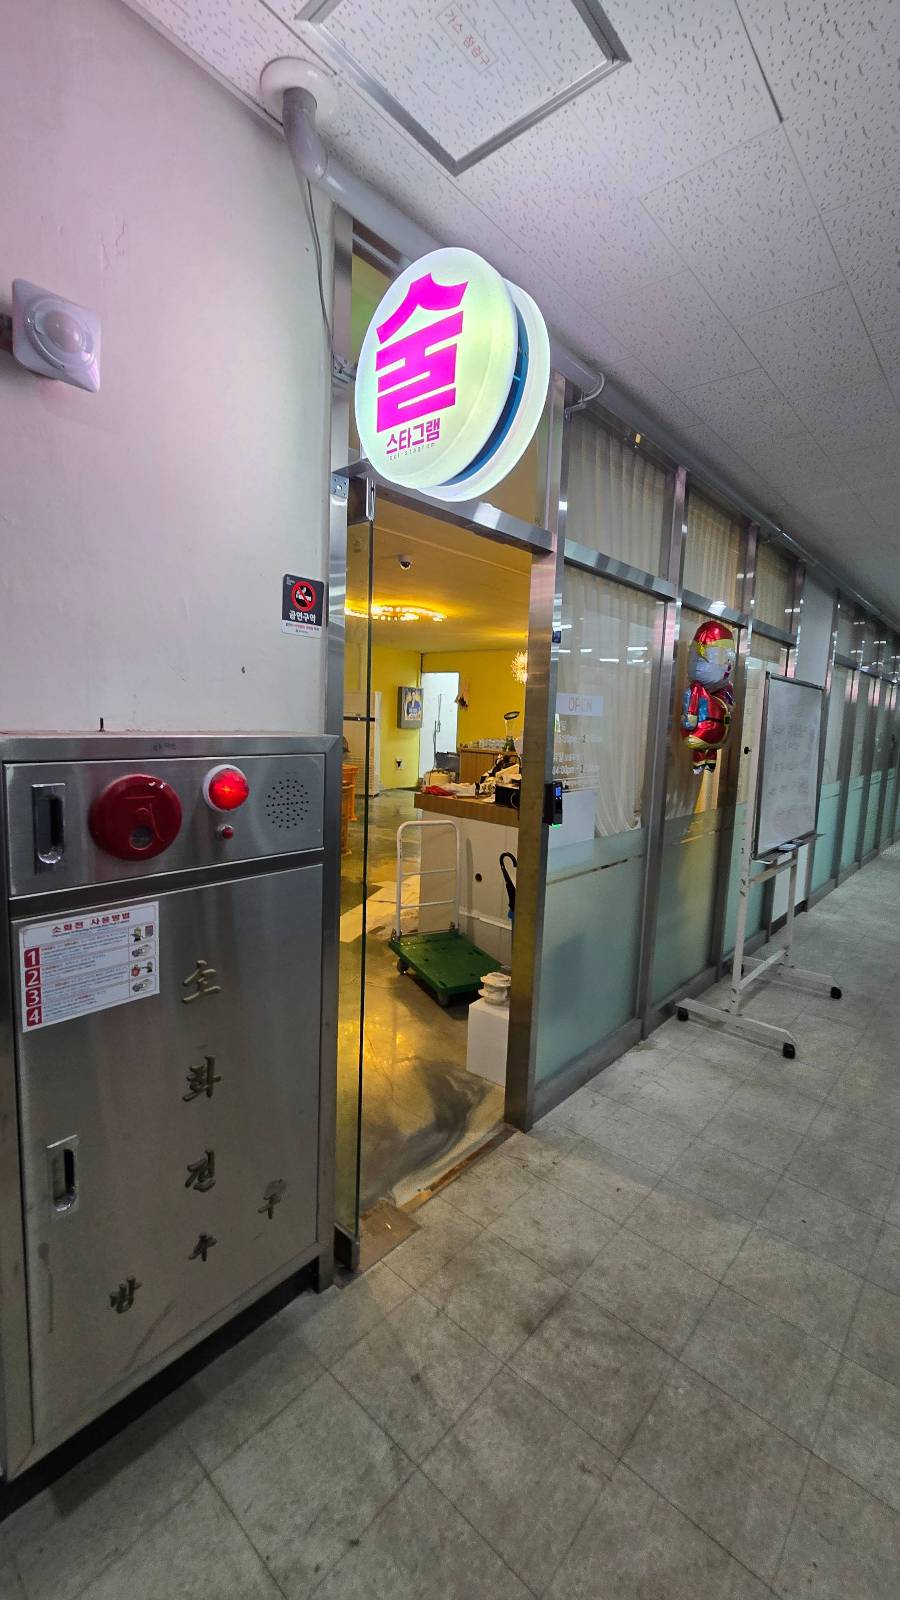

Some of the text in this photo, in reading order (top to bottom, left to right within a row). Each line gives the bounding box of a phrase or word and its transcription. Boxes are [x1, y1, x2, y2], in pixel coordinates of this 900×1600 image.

[375, 272, 468, 433] 술
[387, 418, 440, 454] 스타그램
[288, 609, 316, 624] 금연구역
[52, 912, 131, 934] 소화전 사용방법
[27, 949, 37, 966] 1
[28, 969, 39, 986] 2
[28, 989, 40, 1005] 3
[29, 1007, 40, 1024] 4
